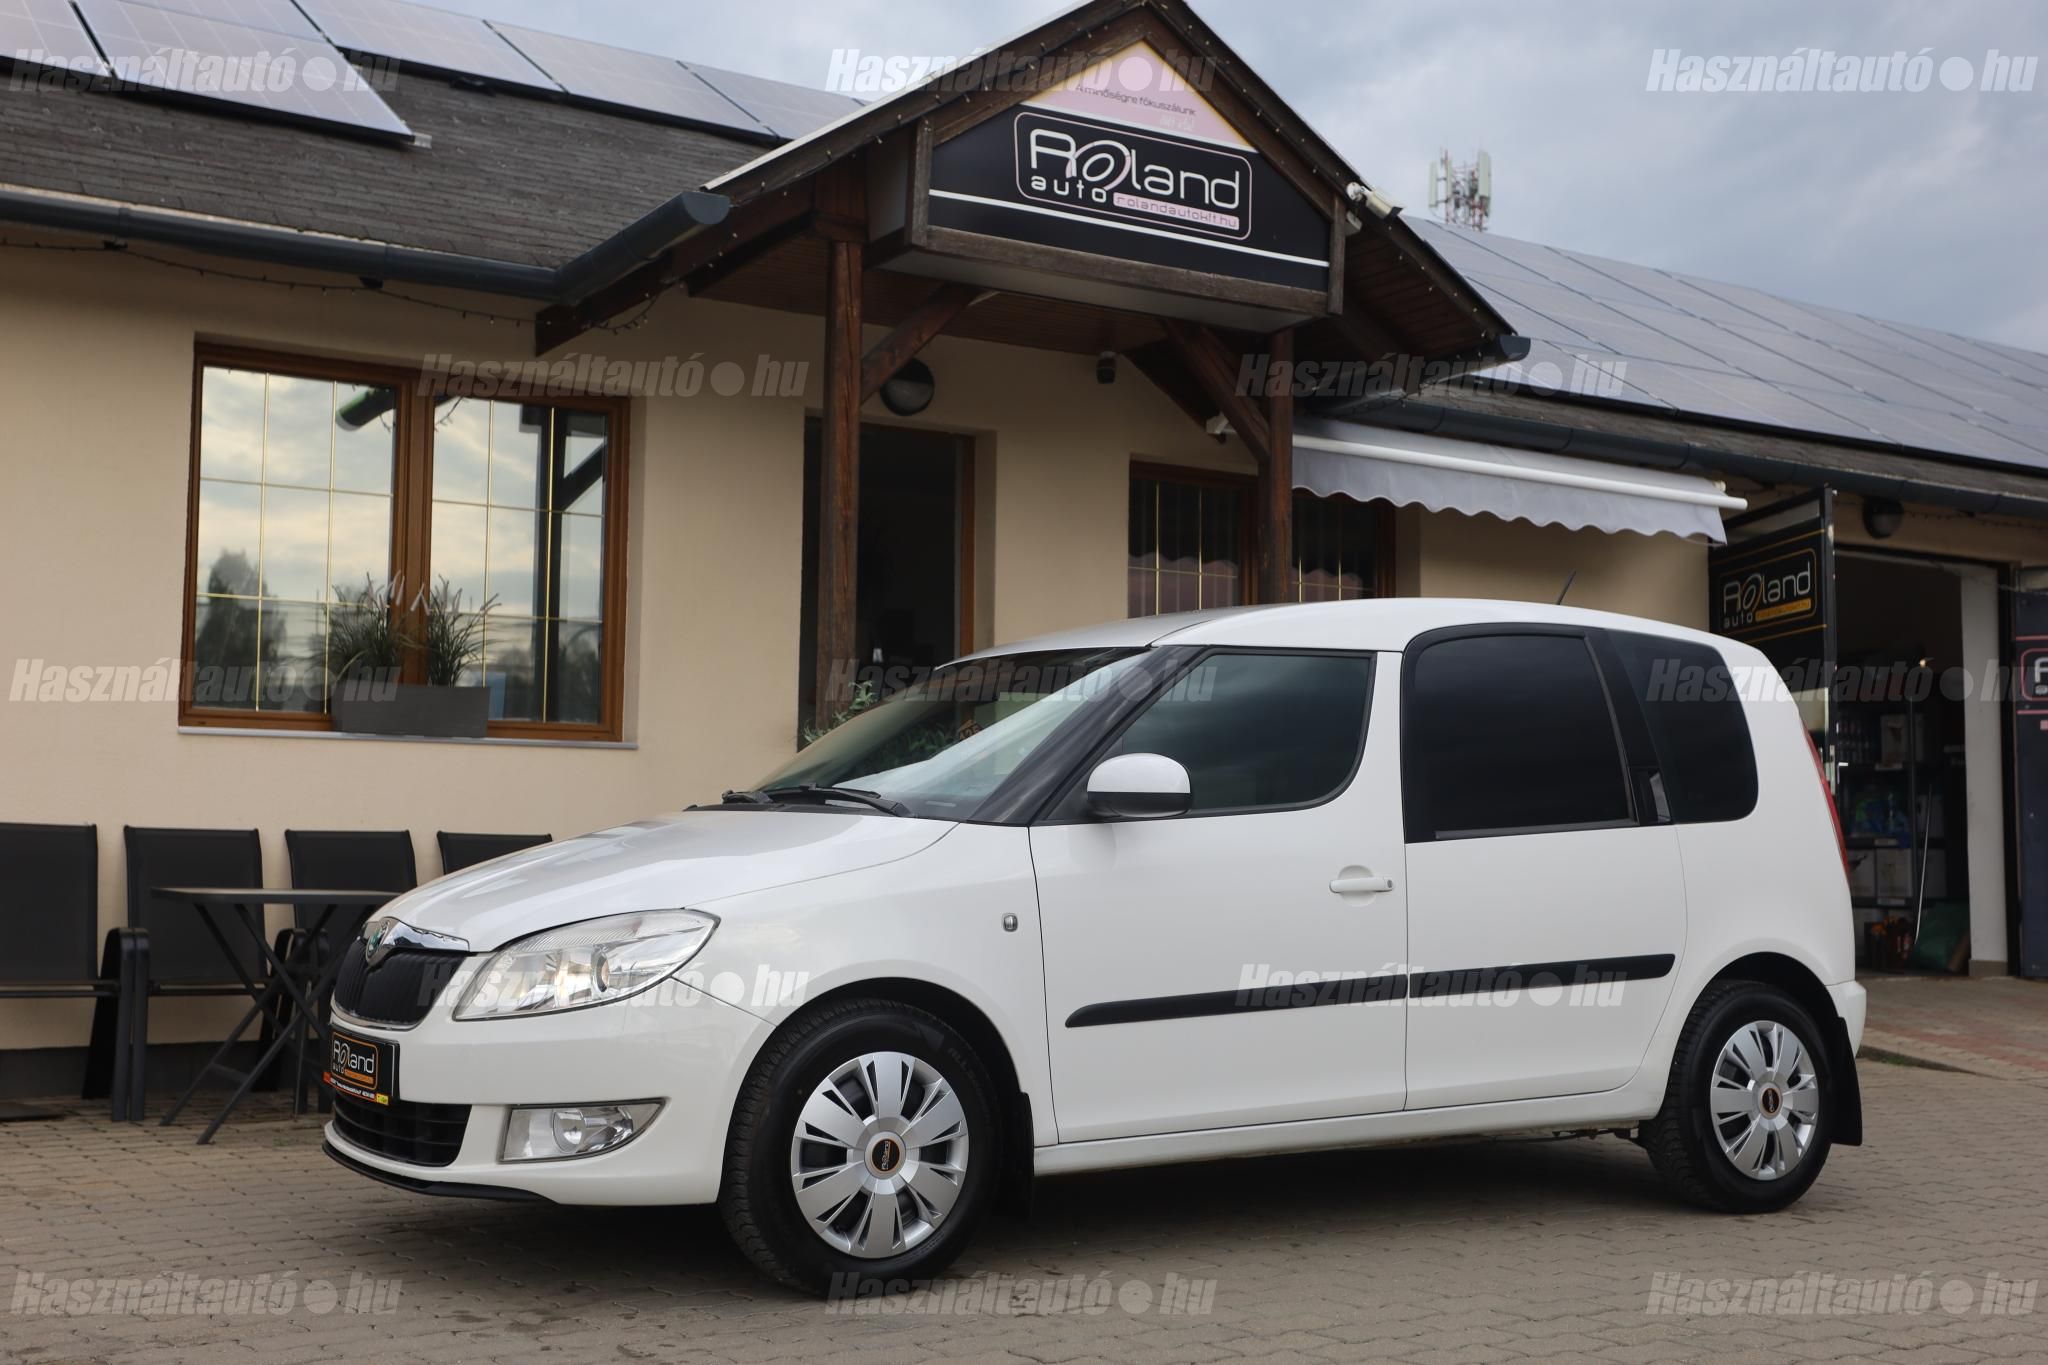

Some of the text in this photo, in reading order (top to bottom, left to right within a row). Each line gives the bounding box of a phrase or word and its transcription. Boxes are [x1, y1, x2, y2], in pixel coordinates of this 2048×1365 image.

[1030, 128, 1240, 209] Roland
[1030, 175, 1107, 203] auto
[1723, 561, 1811, 616] Roland
[333, 1040, 375, 1074] Roland
